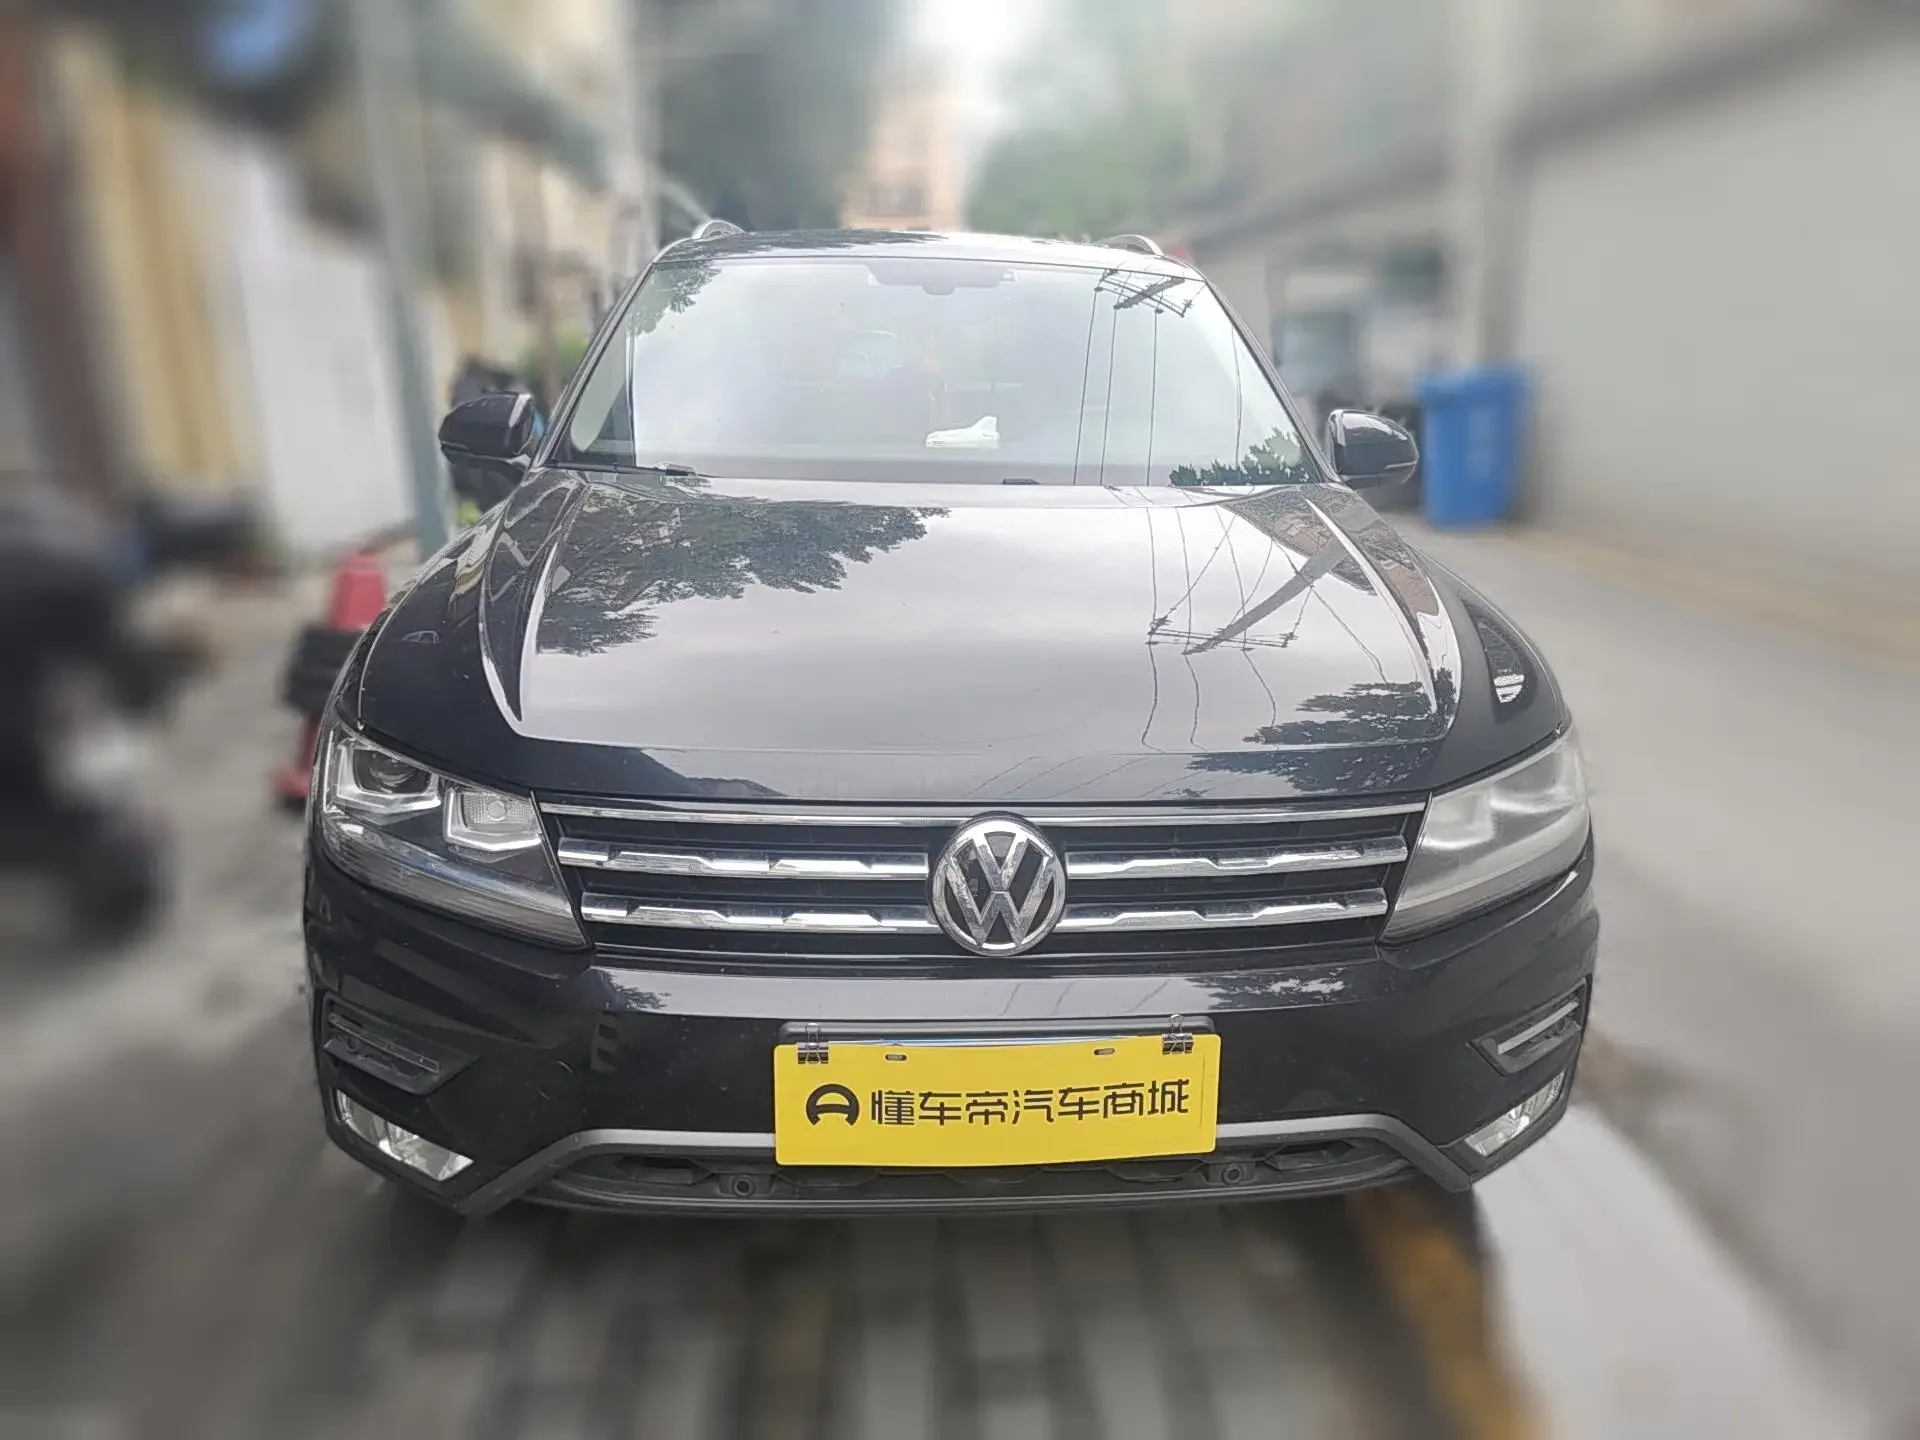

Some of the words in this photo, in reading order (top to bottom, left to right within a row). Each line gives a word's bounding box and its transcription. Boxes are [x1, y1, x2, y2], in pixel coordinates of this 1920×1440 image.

[871, 1079, 1190, 1126] 懂车帝汽车商城
